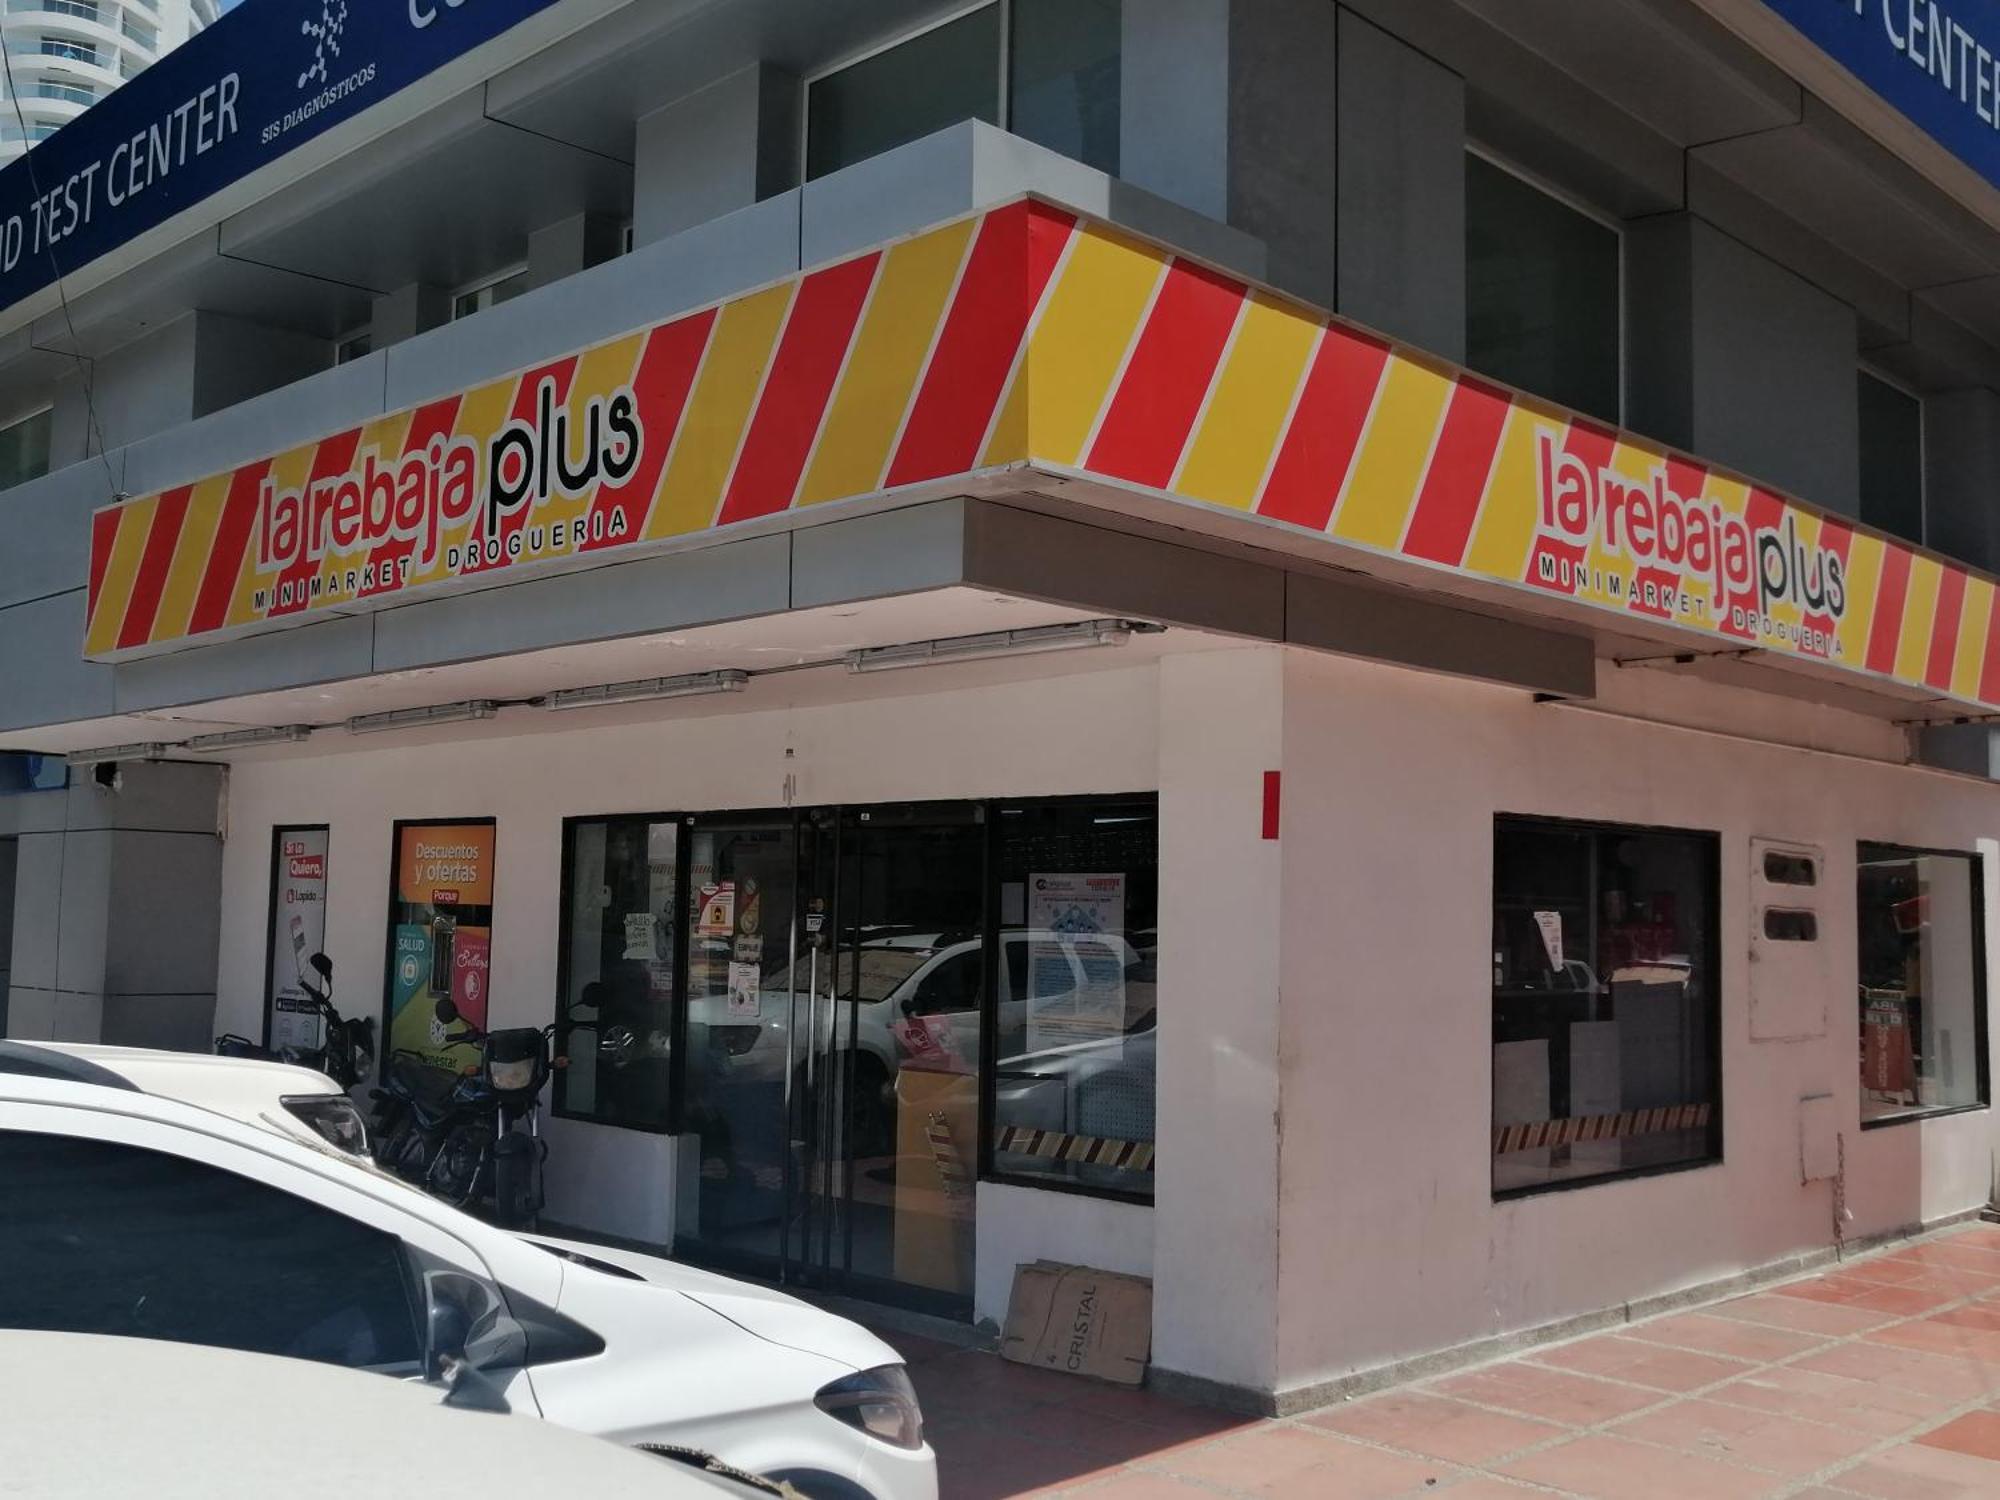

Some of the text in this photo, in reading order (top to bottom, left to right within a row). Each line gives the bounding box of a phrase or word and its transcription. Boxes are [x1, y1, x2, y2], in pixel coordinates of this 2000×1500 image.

[261, 62, 376, 144] SIS DIAGNÓSTICOS
[30, 159, 101, 254] TEST
[107, 72, 240, 207] CENTER
[488, 386, 639, 536] plus
[254, 509, 628, 609] MINIMARKET DROGUERIA
[1758, 515, 1846, 617] plus
[1541, 556, 1844, 655] MINIMARKET DROGUERIA
[415, 843, 479, 859] Descuentos
[415, 860, 477, 885] y ofertas
[398, 938, 425, 951] SALUD
[1067, 1285, 1096, 1370] CRISTAL
